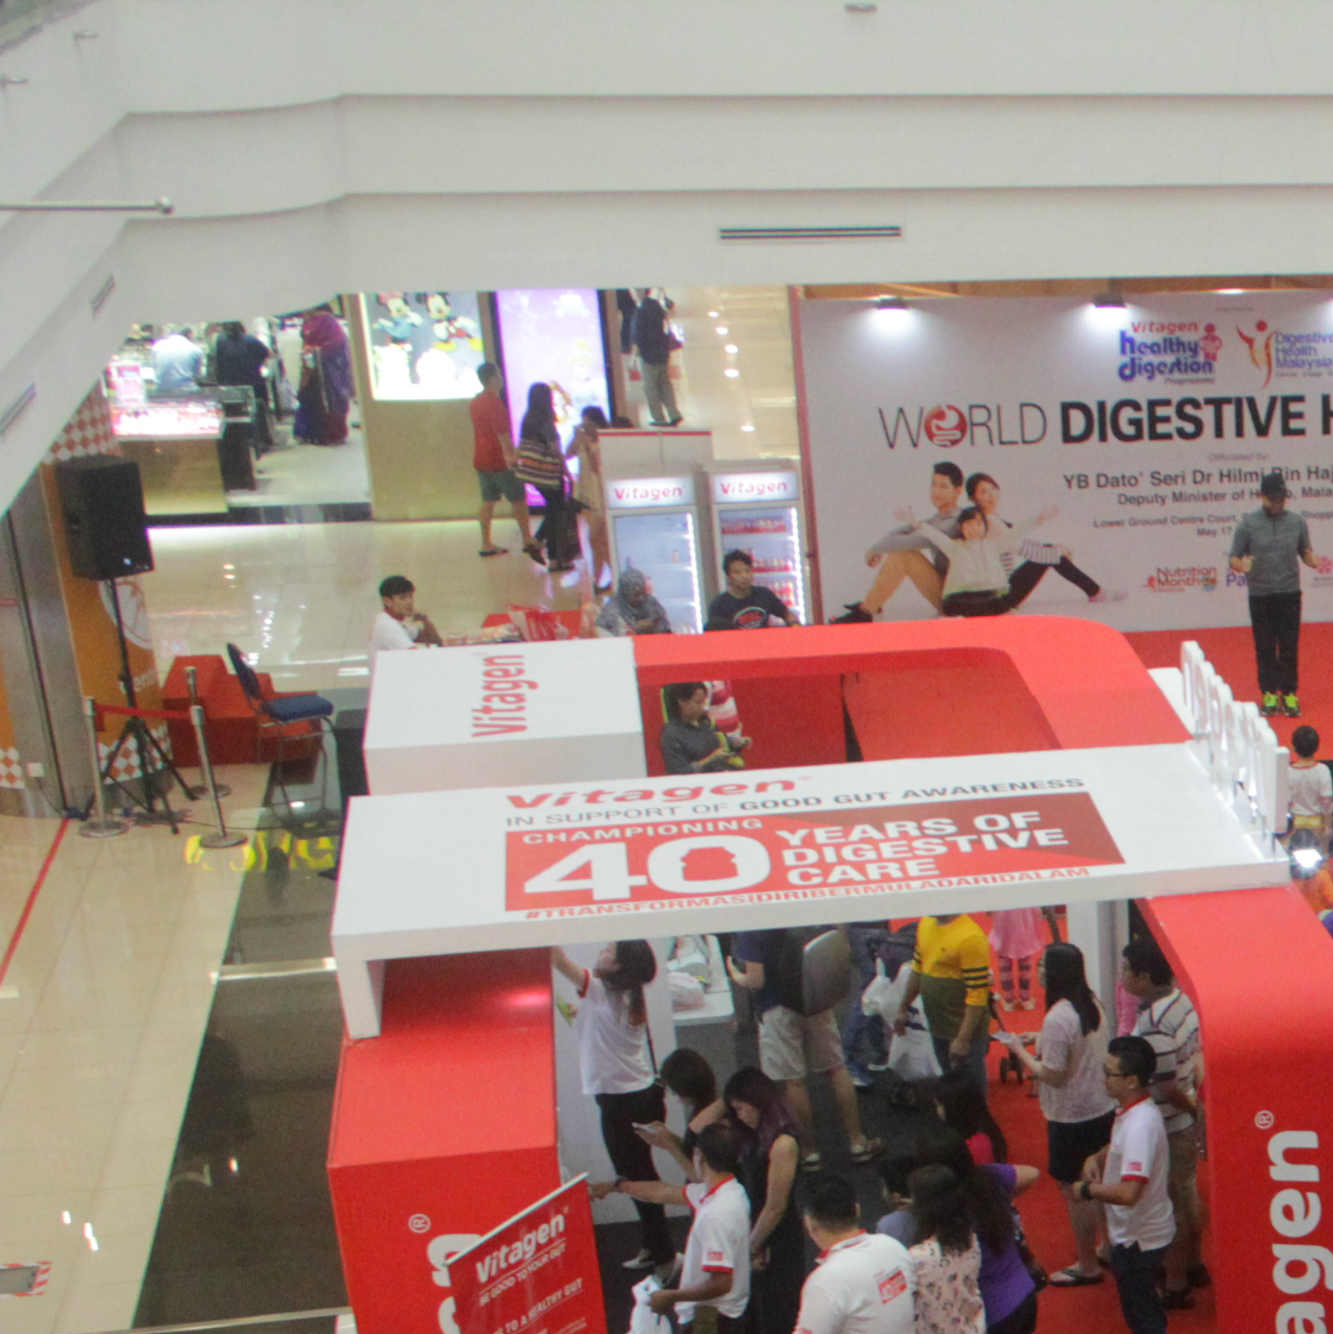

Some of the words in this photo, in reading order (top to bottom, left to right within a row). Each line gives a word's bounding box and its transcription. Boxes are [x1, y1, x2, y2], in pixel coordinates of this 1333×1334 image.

[1131, 321, 1199, 334] Vitagen
[1119, 330, 1199, 358] healthy
[1118, 357, 1214, 381] digestion
[1060, 395, 1307, 444] DIGESTIVE
[615, 486, 684, 500] Vitagen
[720, 480, 789, 495] Vitagen
[1064, 474, 1090, 489] YB
[1150, 470, 1187, 486] Seri
[1192, 469, 1213, 484] Dr
[1117, 491, 1167, 507] Deputy
[1172, 489, 1227, 503] Minister
[471, 652, 540, 740] Vitagen
[506, 779, 797, 809] Vitagen
[506, 816, 535, 827] IN
[546, 806, 680, 825] SUPPORT
[691, 802, 730, 815] OF
[739, 796, 822, 811] GOOD
[834, 790, 889, 805] GUT
[901, 778, 1086, 799] AWARENESS
[522, 818, 764, 844] CHAMPIONING
[776, 816, 959, 846] YEARS
[973, 811, 1042, 833] OF
[782, 828, 1069, 866] DIGESTIVE
[523, 834, 773, 901] 40
[786, 858, 941, 887] CARE
[476, 1213, 566, 1284] Vitagen
